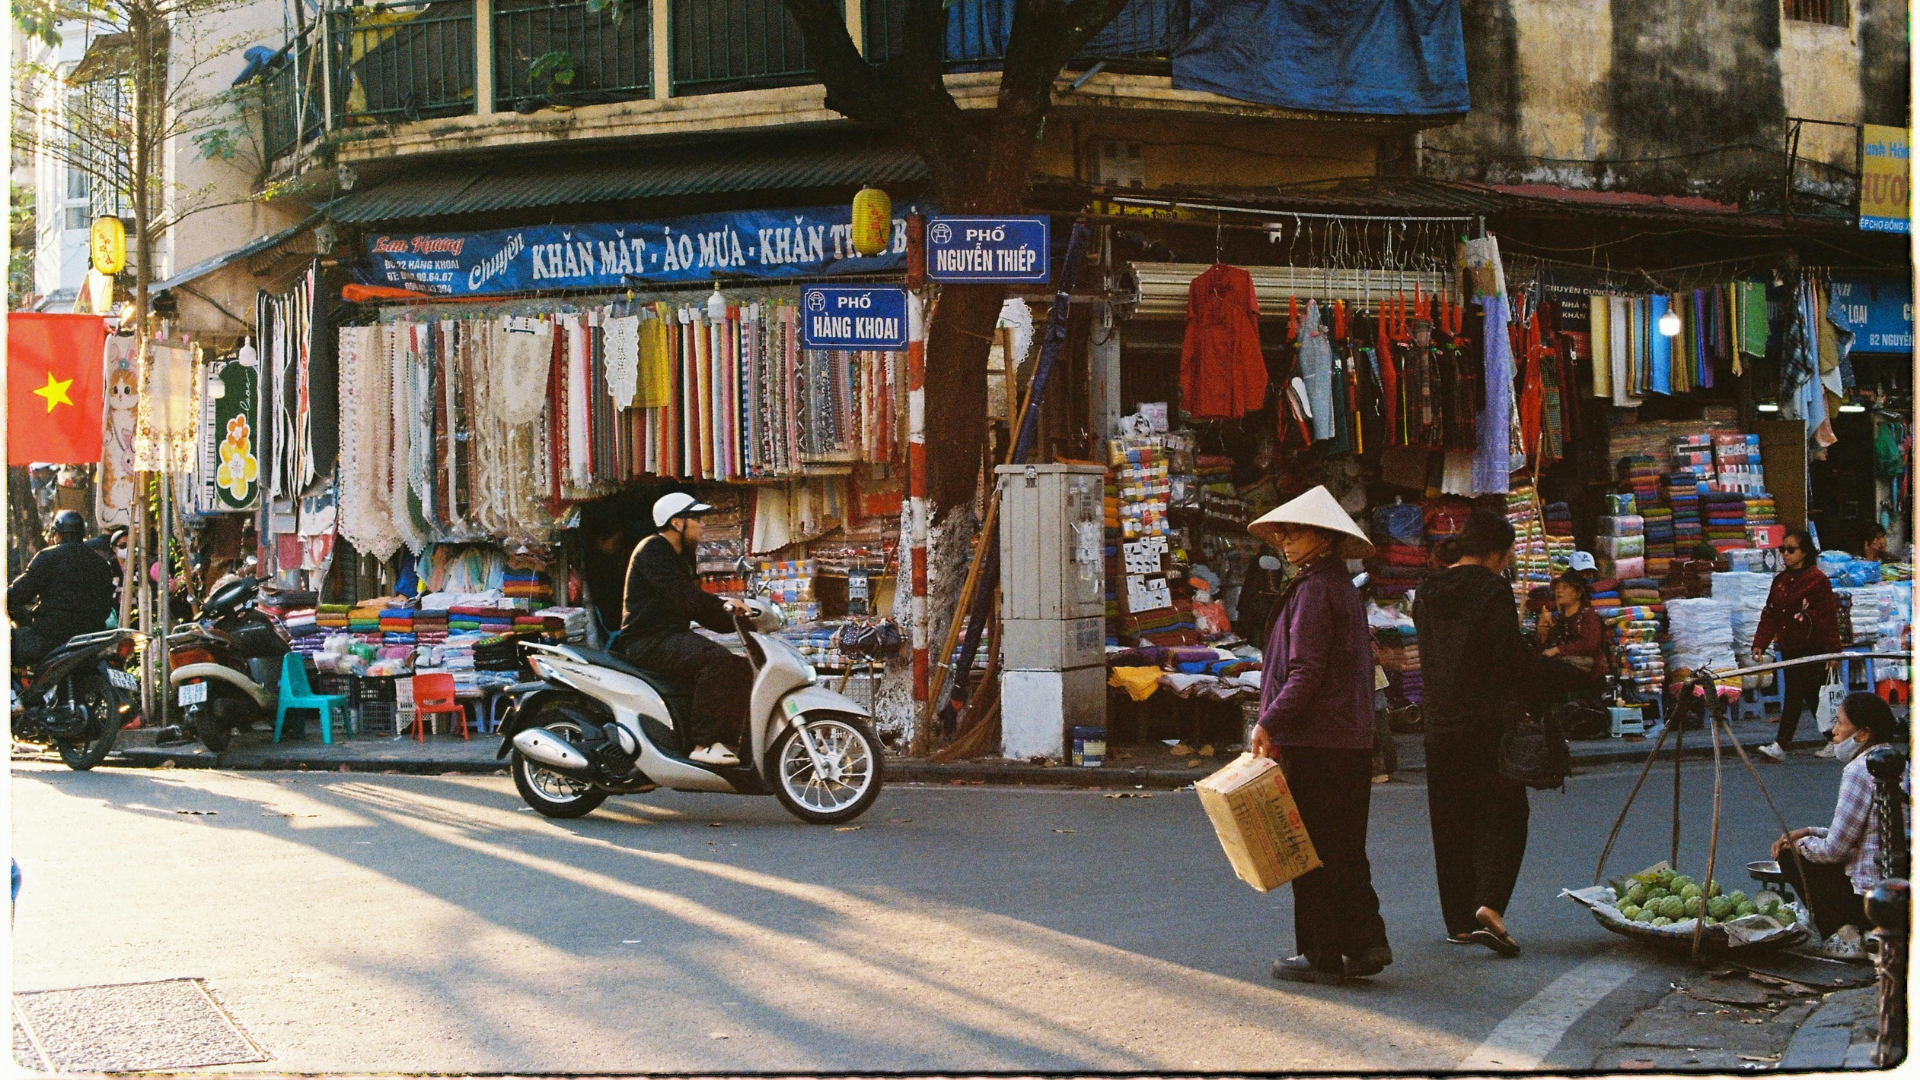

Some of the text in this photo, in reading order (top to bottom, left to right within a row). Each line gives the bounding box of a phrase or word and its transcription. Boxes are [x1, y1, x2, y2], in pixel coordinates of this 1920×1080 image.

[372, 235, 408, 254] Lan
[966, 224, 1005, 242] PHỐ
[532, 231, 595, 280] KHĂN
[699, 224, 746, 268] MƯA
[759, 215, 825, 264] KHĂN
[937, 243, 1036, 272] NGUYỄN THIẾP
[408, 258, 433, 270] HÀNG
[434, 259, 460, 270] KHOAI
[467, 233, 525, 291] Chuyên
[837, 292, 872, 309] PHỐ
[813, 312, 899, 340] HÀNG KHOAI
[1848, 304, 1868, 328] LOẠI
